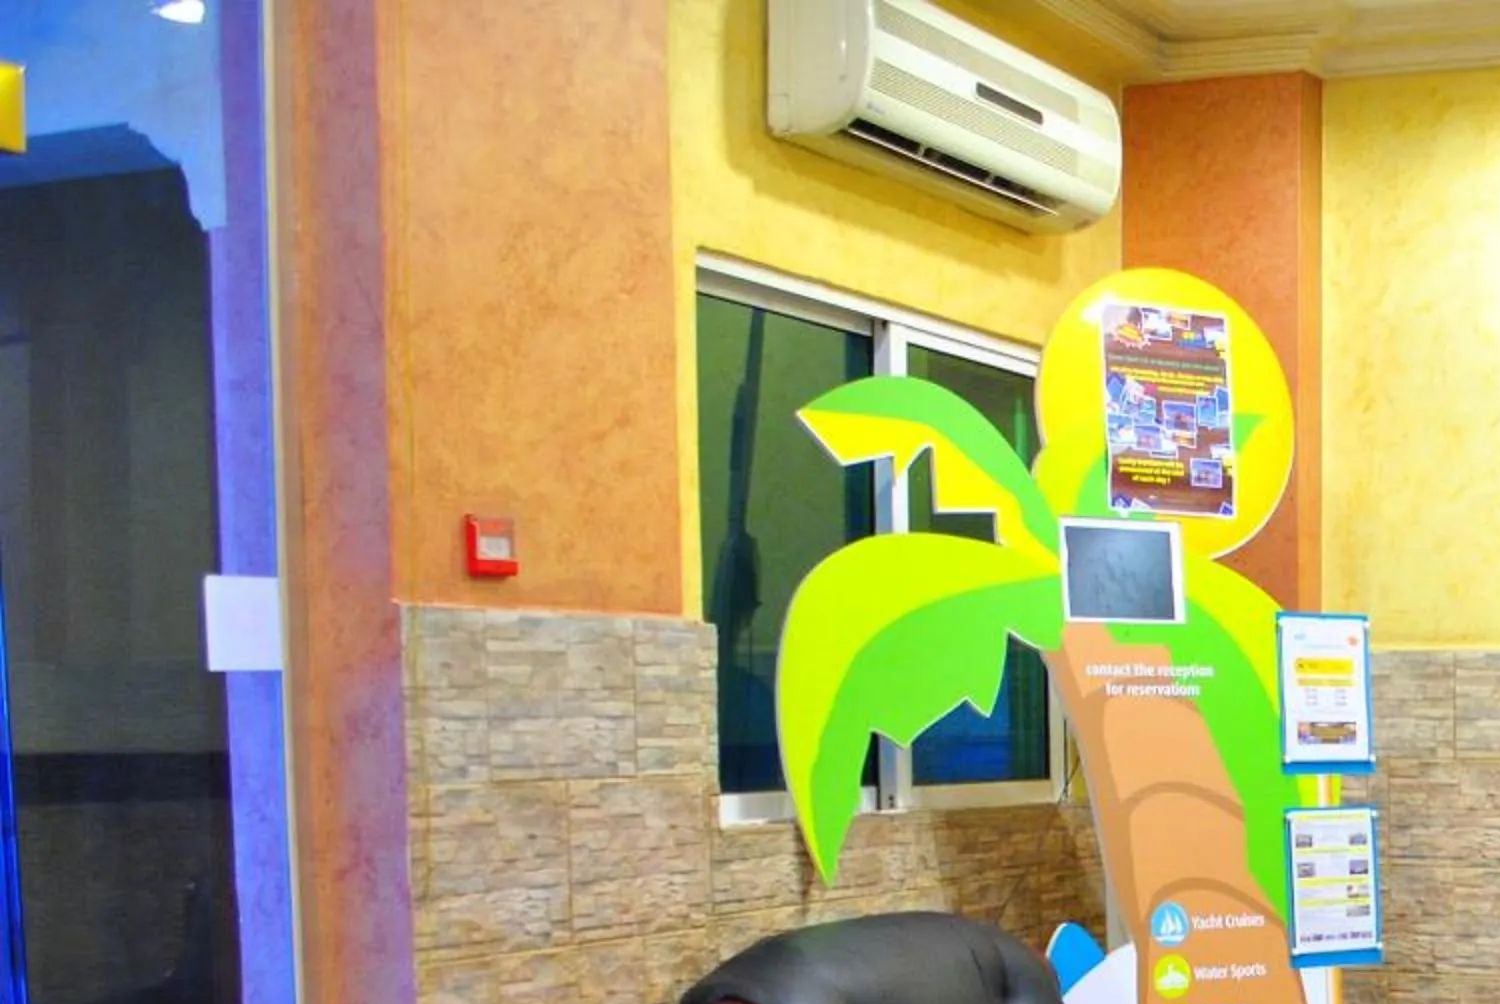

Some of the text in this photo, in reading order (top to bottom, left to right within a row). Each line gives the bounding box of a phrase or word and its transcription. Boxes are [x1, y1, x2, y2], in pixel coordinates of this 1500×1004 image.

[1086, 663, 1215, 680] contact the reception
[1105, 681, 1200, 697] for reservations
[1191, 912, 1265, 930] Yacht Cruises
[1194, 962, 1267, 982] Water Sports
